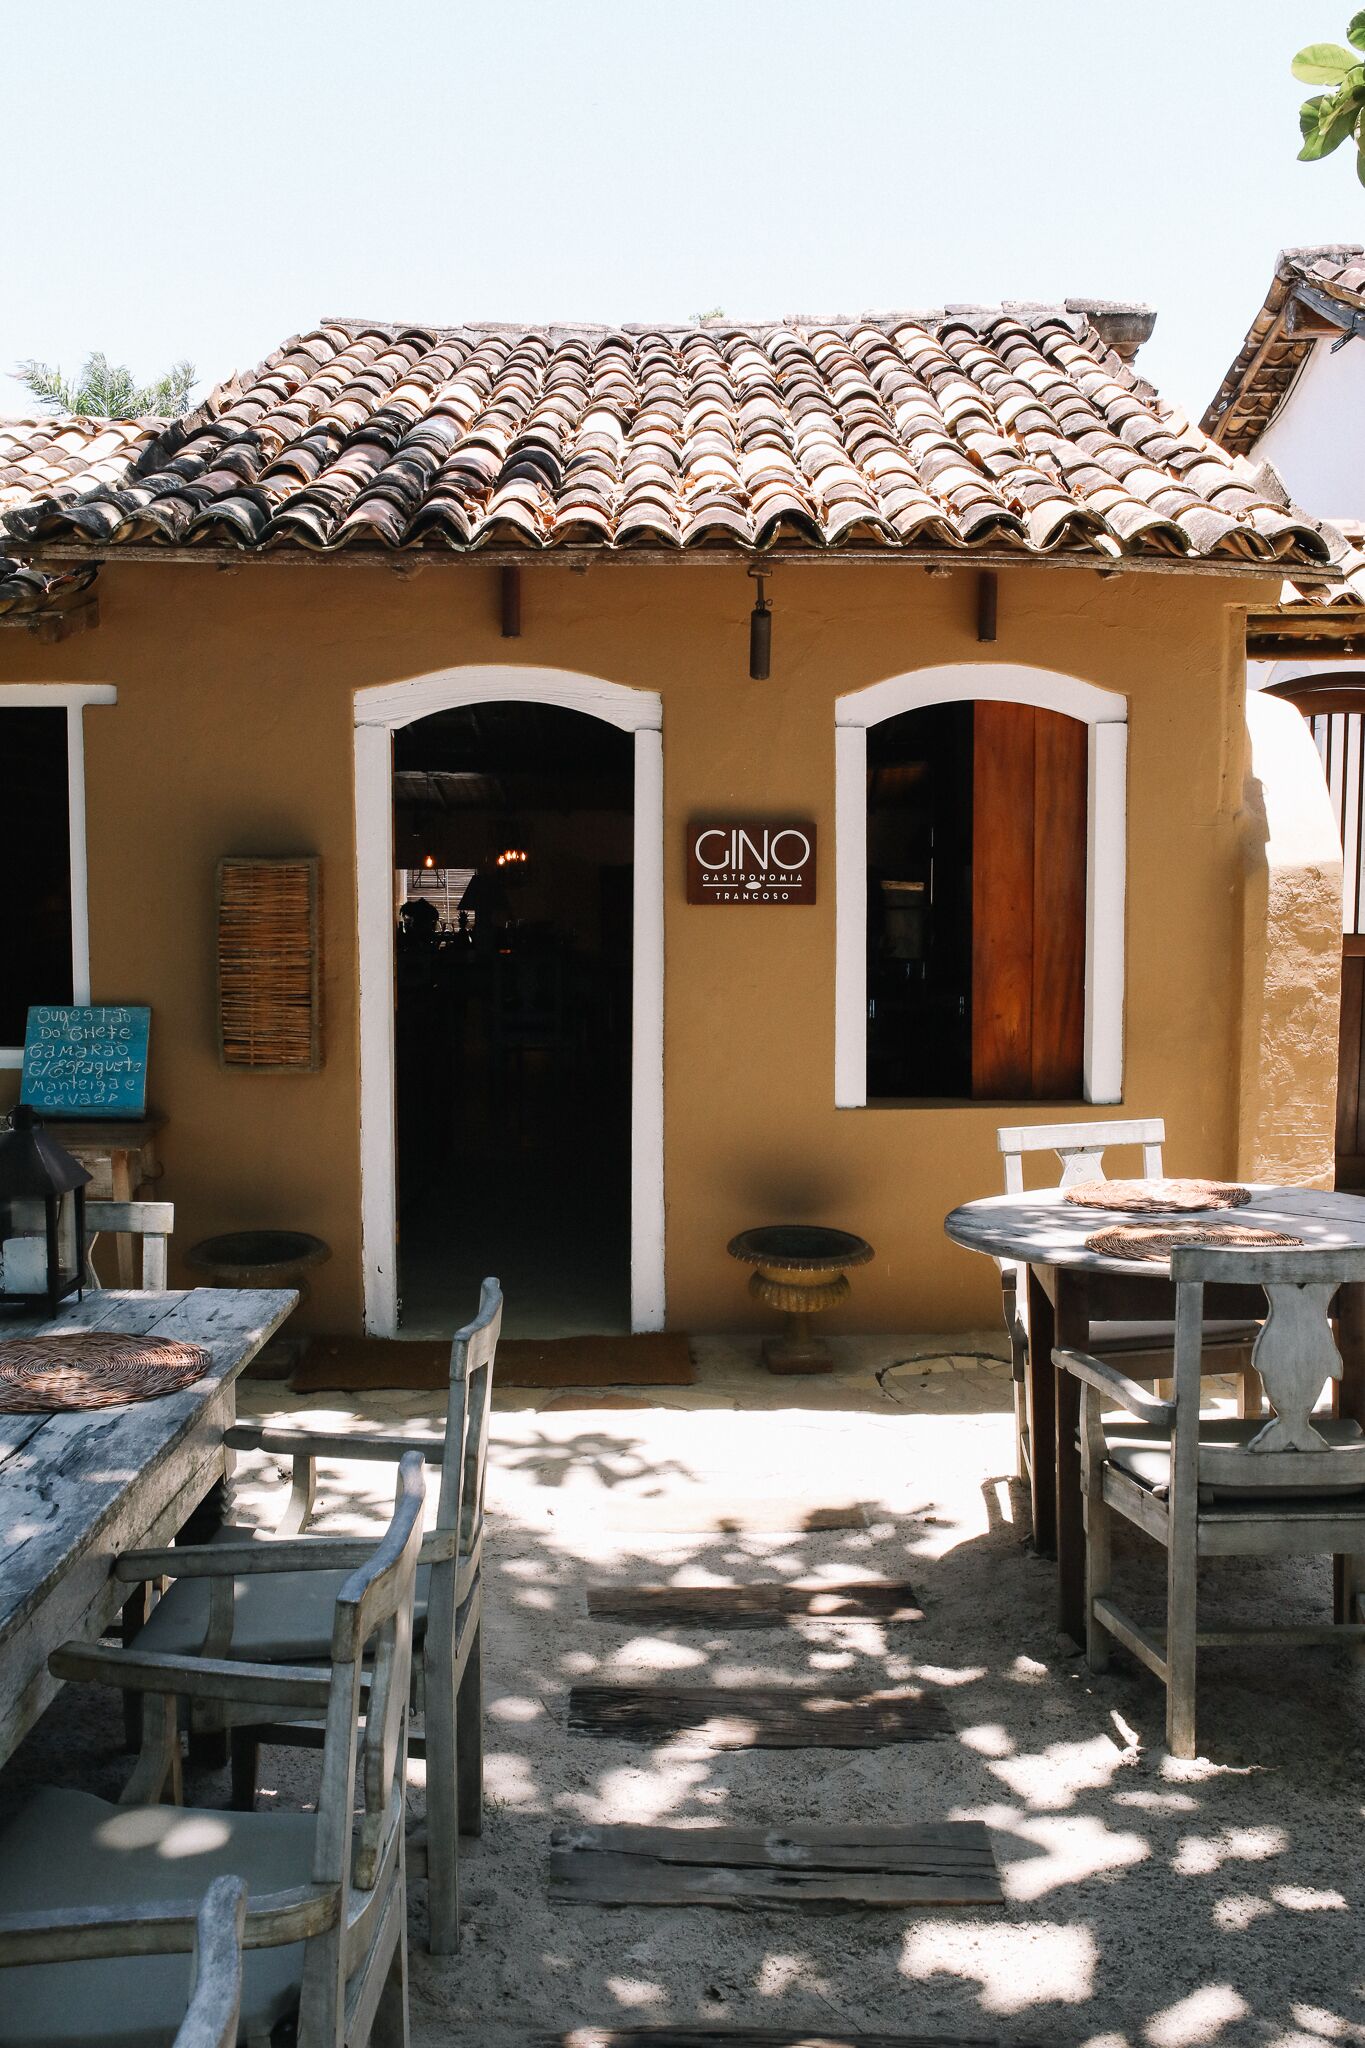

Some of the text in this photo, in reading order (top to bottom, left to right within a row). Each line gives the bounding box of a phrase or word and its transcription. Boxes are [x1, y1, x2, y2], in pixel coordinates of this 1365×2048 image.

[695, 829, 811, 870] GINO
[702, 873, 803, 882] GASTRONOMIA
[715, 892, 789, 900] TRANCOSO
